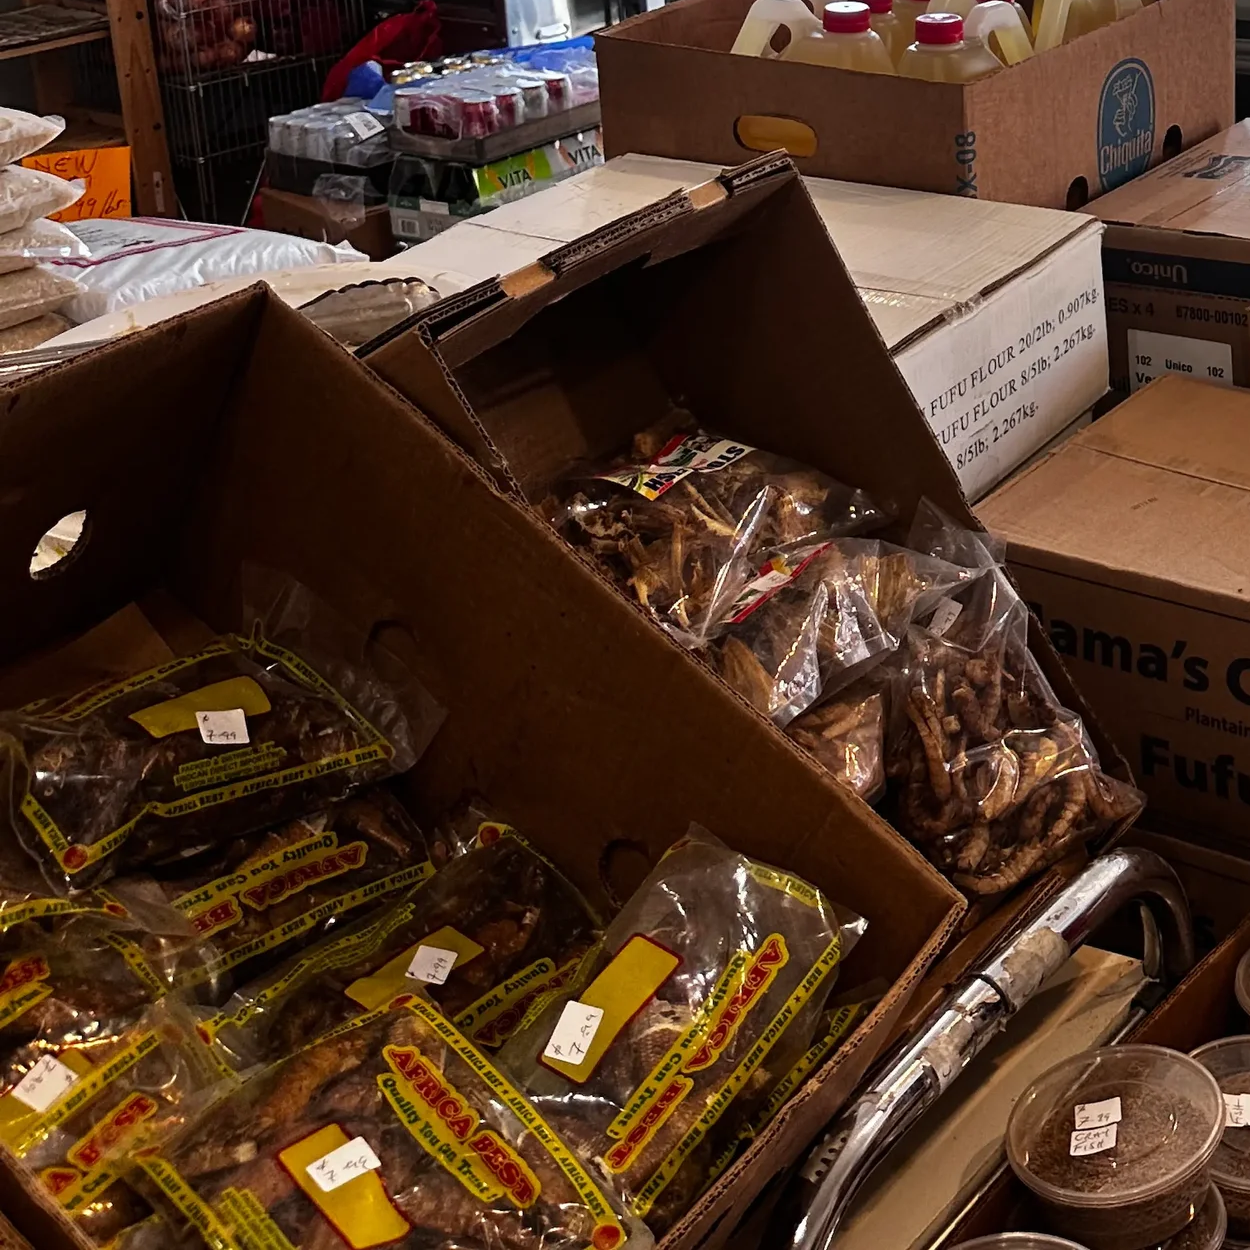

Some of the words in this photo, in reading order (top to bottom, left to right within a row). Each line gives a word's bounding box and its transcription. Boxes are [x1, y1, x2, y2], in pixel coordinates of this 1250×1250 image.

[33, 153, 97, 174] NEW
[567, 145, 601, 165] VITA
[1100, 130, 1152, 175] Chiquita
[498, 168, 532, 189] VITA
[1131, 260, 1188, 284] Unico
[1144, 301, 1155, 316] 4
[929, 381, 967, 418] FUFU
[970, 345, 1016, 389] FLOUR
[1134, 354, 1153, 367] 102
[1164, 358, 1193, 374] Unico
[1206, 366, 1225, 379] 102
[973, 378, 1018, 424] FLOUR
[1030, 601, 1210, 693] ama's
[199, 791, 225, 807] BEST
[242, 778, 280, 794] AFRICA
[281, 770, 306, 785] BEST
[354, 749, 380, 764] BEST
[282, 835, 335, 864] Quality
[215, 873, 249, 894] Can
[247, 845, 363, 902] AFRICA
[250, 859, 280, 879] You
[503, 962, 550, 995] Quality
[802, 968, 823, 993] BEST
[477, 993, 504, 1013] You
[685, 938, 782, 1070] AFRICA
[763, 1006, 794, 1044] AFRICA
[654, 1052, 683, 1083] Can
[743, 1045, 766, 1077] BEST
[382, 1077, 420, 1123] Quality
[418, 1120, 438, 1148] You
[413, 1003, 438, 1026] AFRICA
[437, 1021, 454, 1038] BEST
[460, 1046, 485, 1072] AFRICA
[485, 1066, 505, 1089] BEST
[509, 1096, 537, 1130] AFRICA
[533, 1124, 553, 1146] BEST
[560, 1156, 588, 1191] AFRICA
[585, 1188, 606, 1218] BEST
[619, 1086, 657, 1128] Trust
[701, 1084, 734, 1129] AFRICA
[389, 1048, 473, 1141] AFRICA
[469, 1133, 535, 1204] BEST
[613, 1080, 685, 1168] BEST
[1073, 1141, 1104, 1153] FISH
